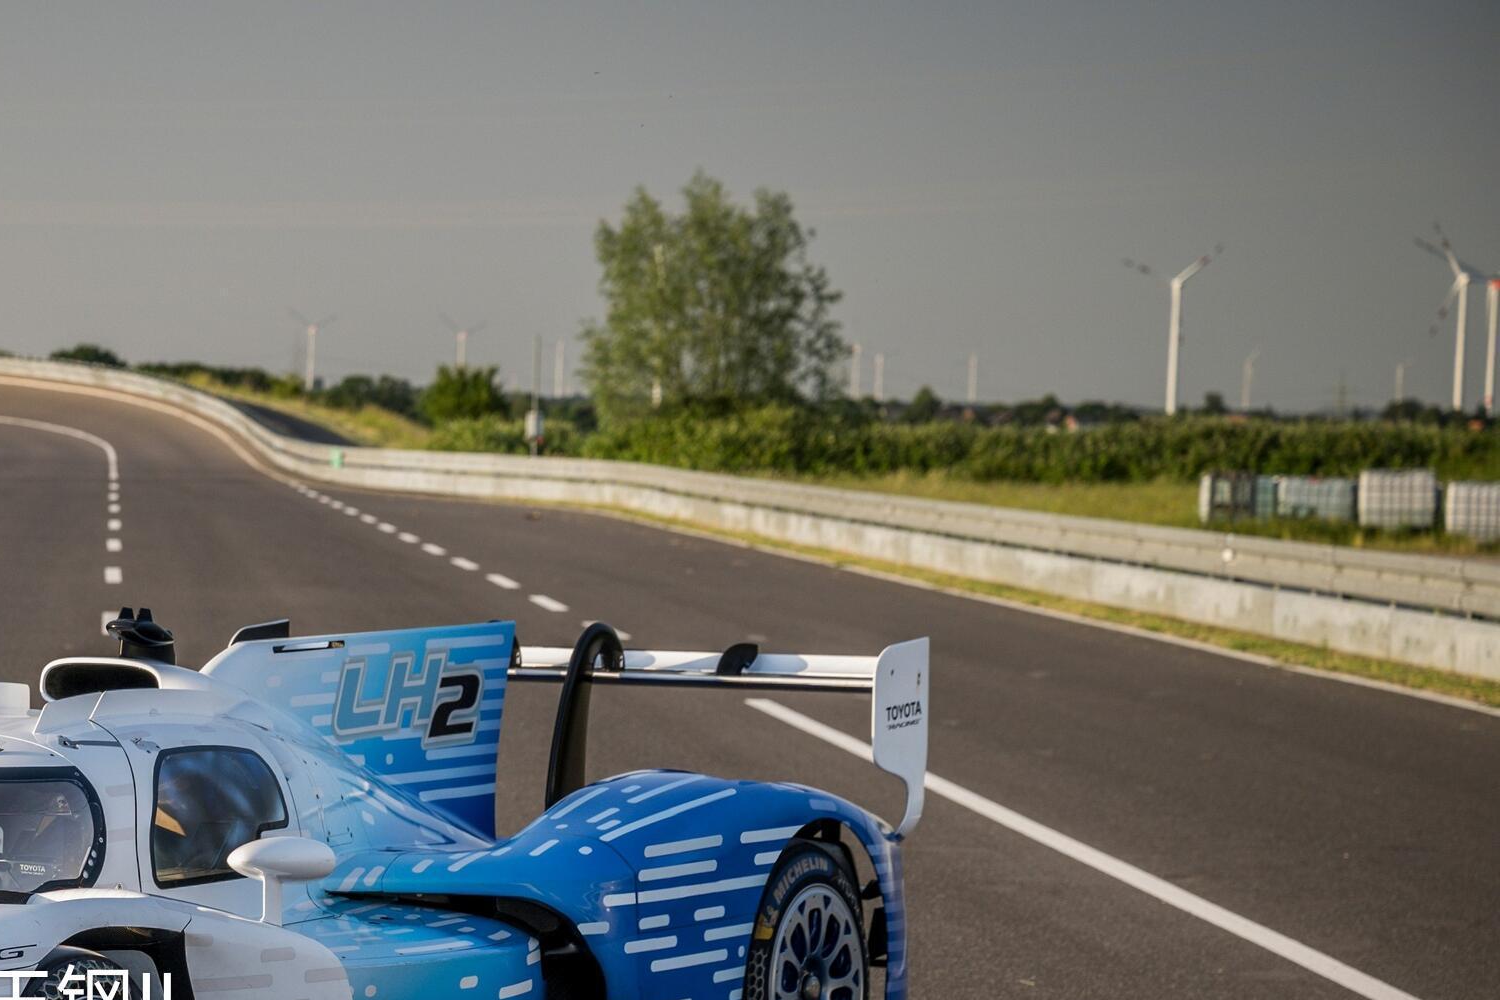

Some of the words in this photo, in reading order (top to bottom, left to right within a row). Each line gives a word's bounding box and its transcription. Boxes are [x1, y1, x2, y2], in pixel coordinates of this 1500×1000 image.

[334, 650, 483, 748] LH2
[886, 701, 922, 721] TOYOTA
[20, 864, 46, 873] TOYOTA
[773, 857, 829, 904] MICHELIN
